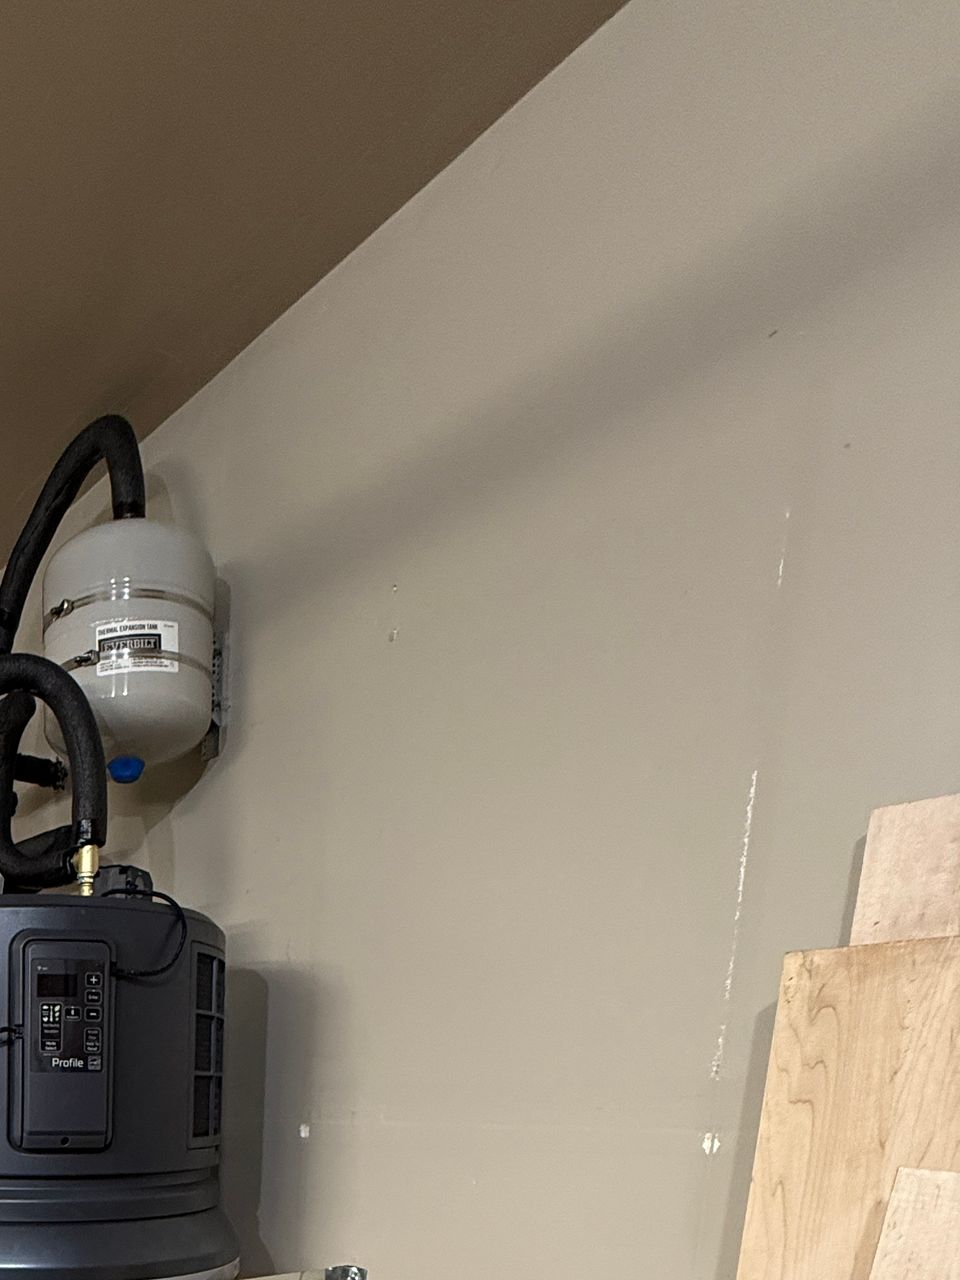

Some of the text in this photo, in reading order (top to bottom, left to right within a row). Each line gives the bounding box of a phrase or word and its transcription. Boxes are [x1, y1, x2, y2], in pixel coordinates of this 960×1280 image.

[98, 627, 118, 636] THERMAL
[120, 624, 146, 632] EXPANSION
[104, 639, 156, 652] EVERBILT
[52, 1057, 84, 1068] Profile
